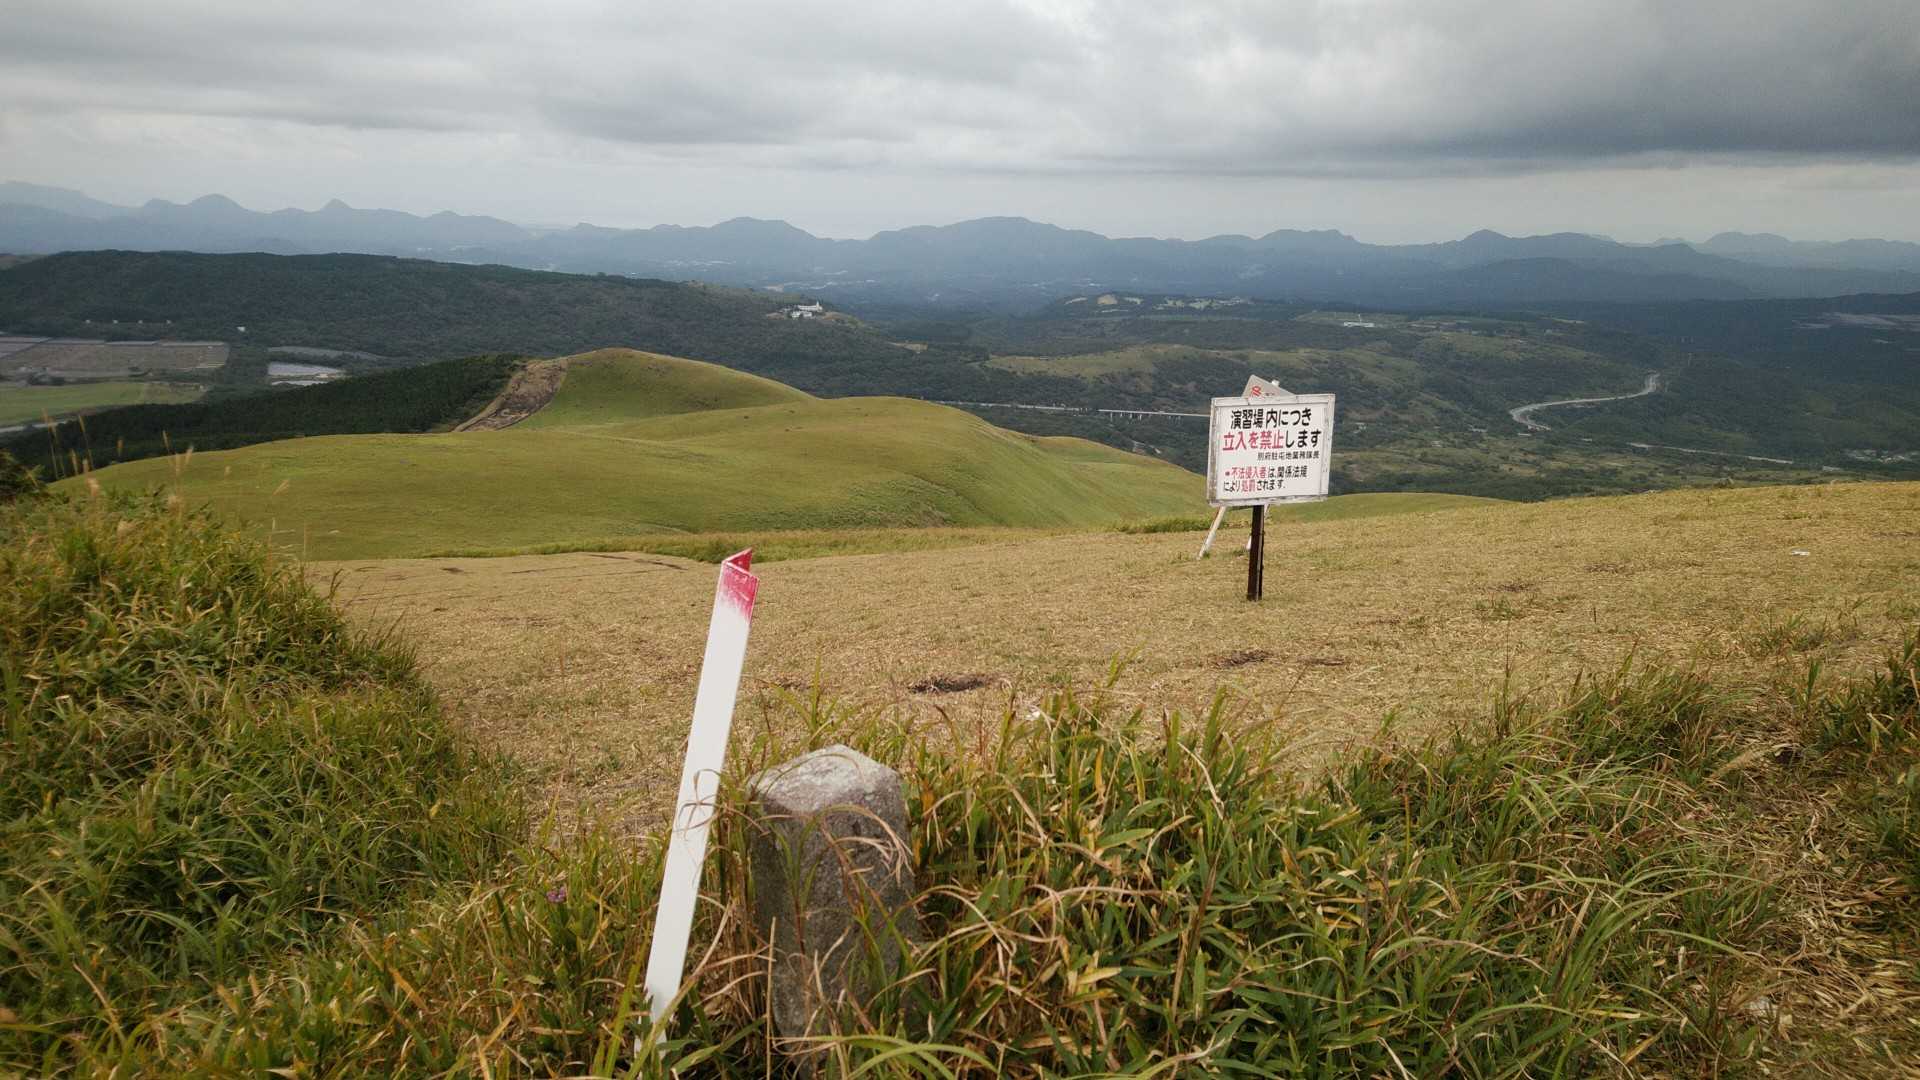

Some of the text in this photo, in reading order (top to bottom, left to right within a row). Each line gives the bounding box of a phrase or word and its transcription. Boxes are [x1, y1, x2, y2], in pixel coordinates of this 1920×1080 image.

[1230, 407, 1312, 430] 演習場内につき
[1222, 429, 1322, 451] 立入を禁止します
